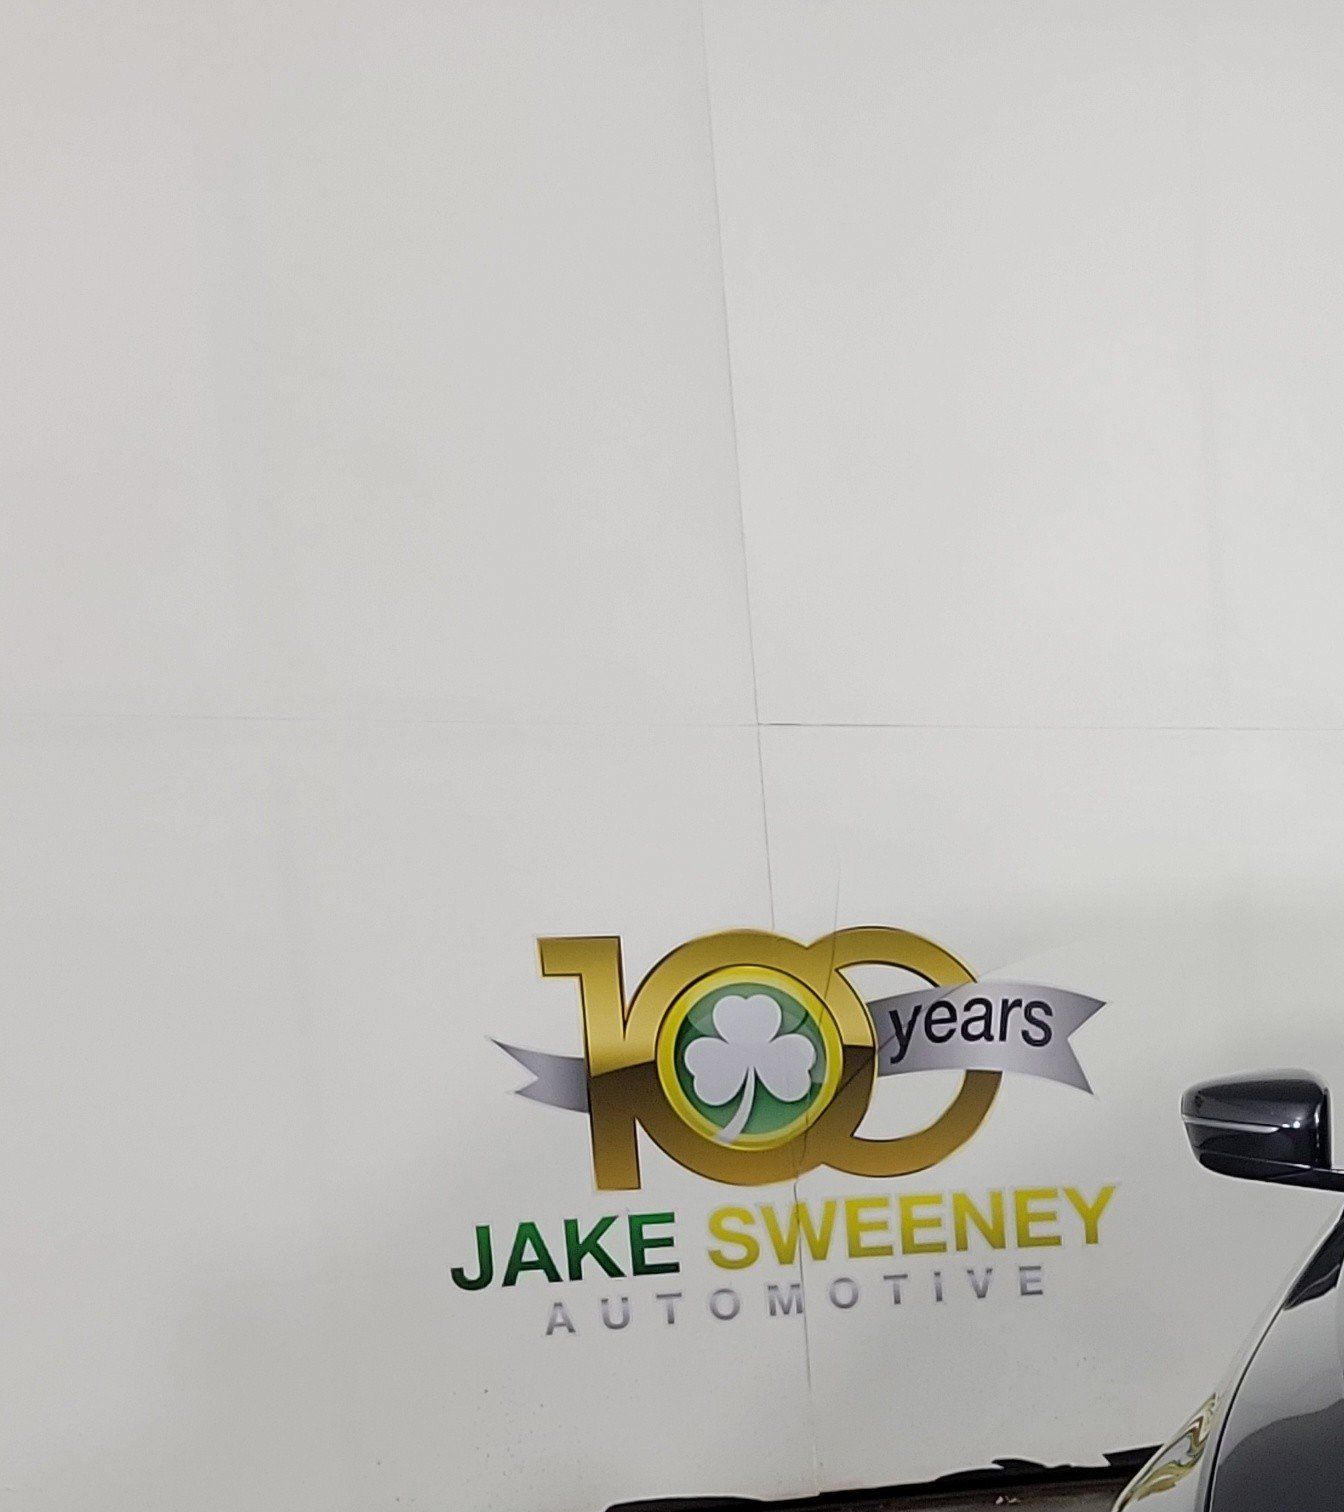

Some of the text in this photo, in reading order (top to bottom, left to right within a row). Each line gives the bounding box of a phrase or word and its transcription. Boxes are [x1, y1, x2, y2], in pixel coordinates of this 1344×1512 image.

[536, 926, 1054, 1191] 100 years
[450, 1185, 1118, 1291] JAKE SWEENEY
[544, 1265, 1045, 1337] AUTOMOTIVE
